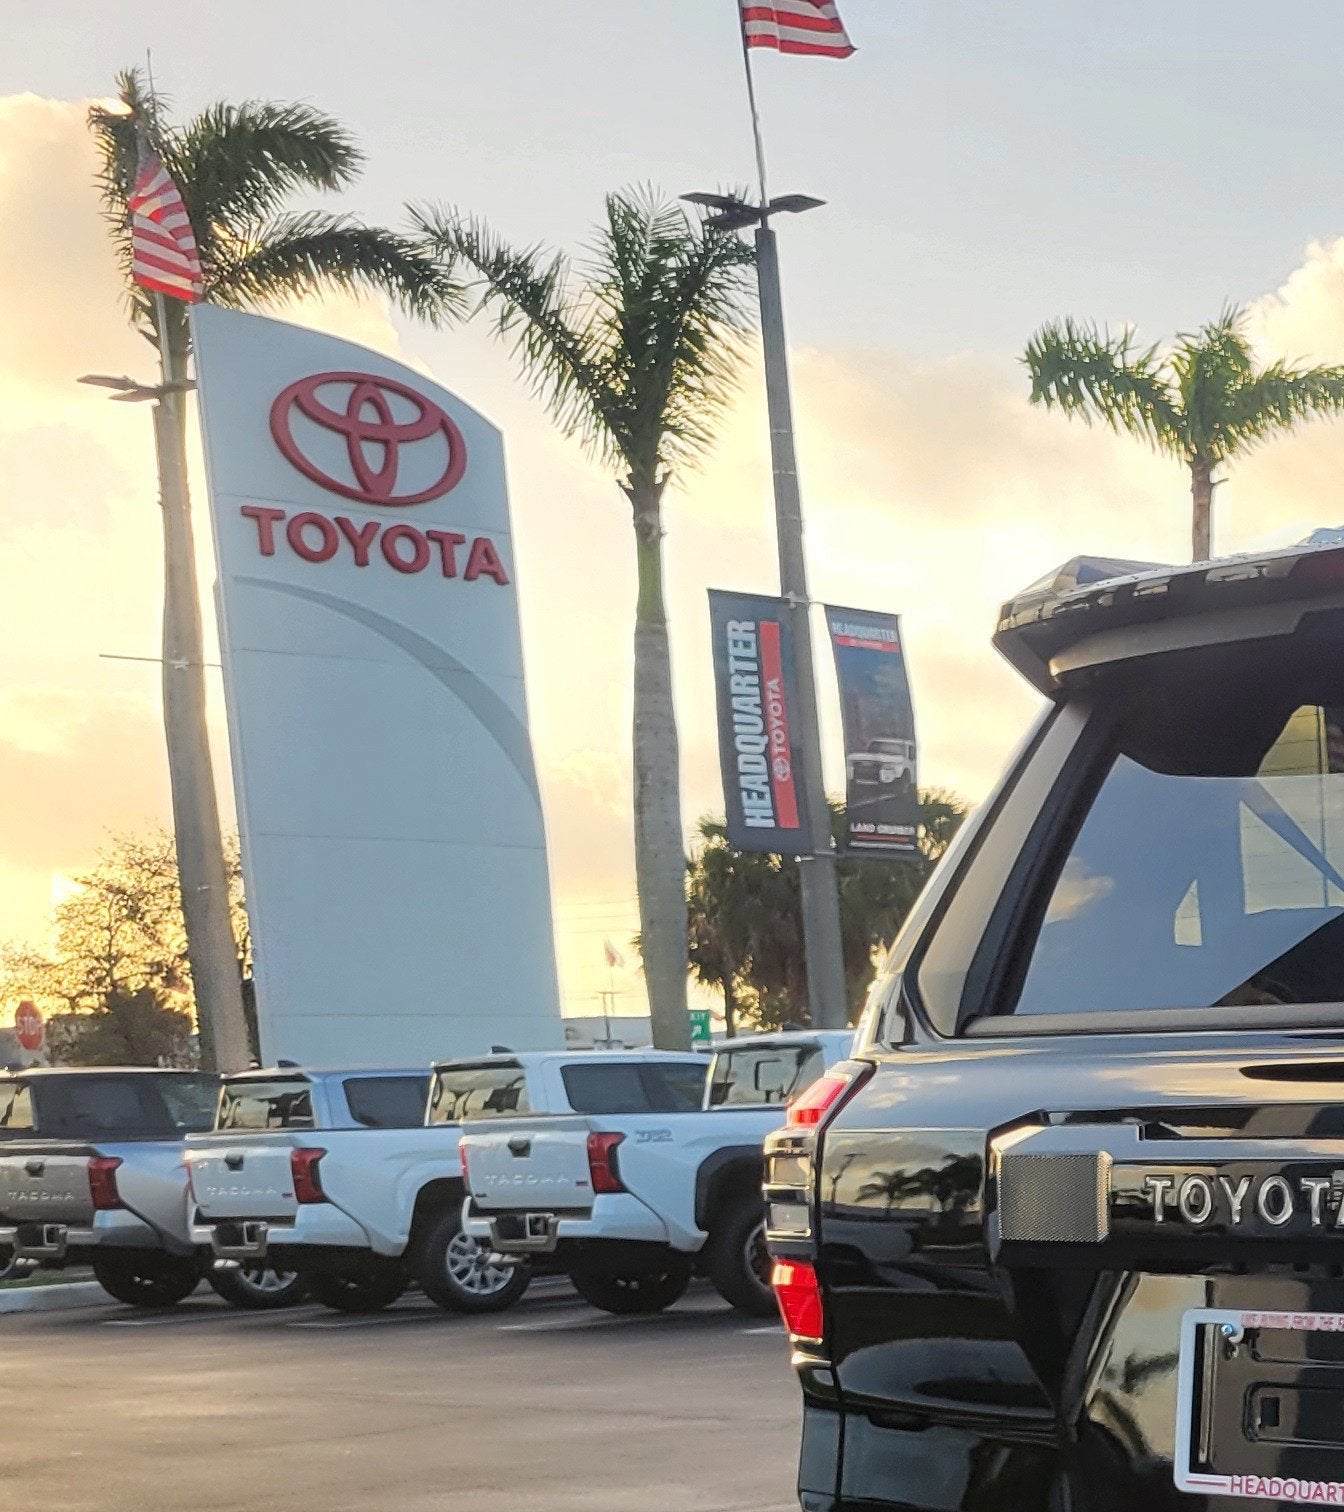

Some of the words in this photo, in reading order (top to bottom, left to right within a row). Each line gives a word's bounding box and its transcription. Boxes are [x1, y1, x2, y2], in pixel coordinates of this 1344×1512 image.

[241, 505, 510, 586] TOYOTA
[727, 619, 776, 829] HEADQUARTER
[766, 678, 788, 755] TOYOTA
[8, 1191, 75, 1201] TACOMA
[484, 1174, 569, 1185] TACOMA
